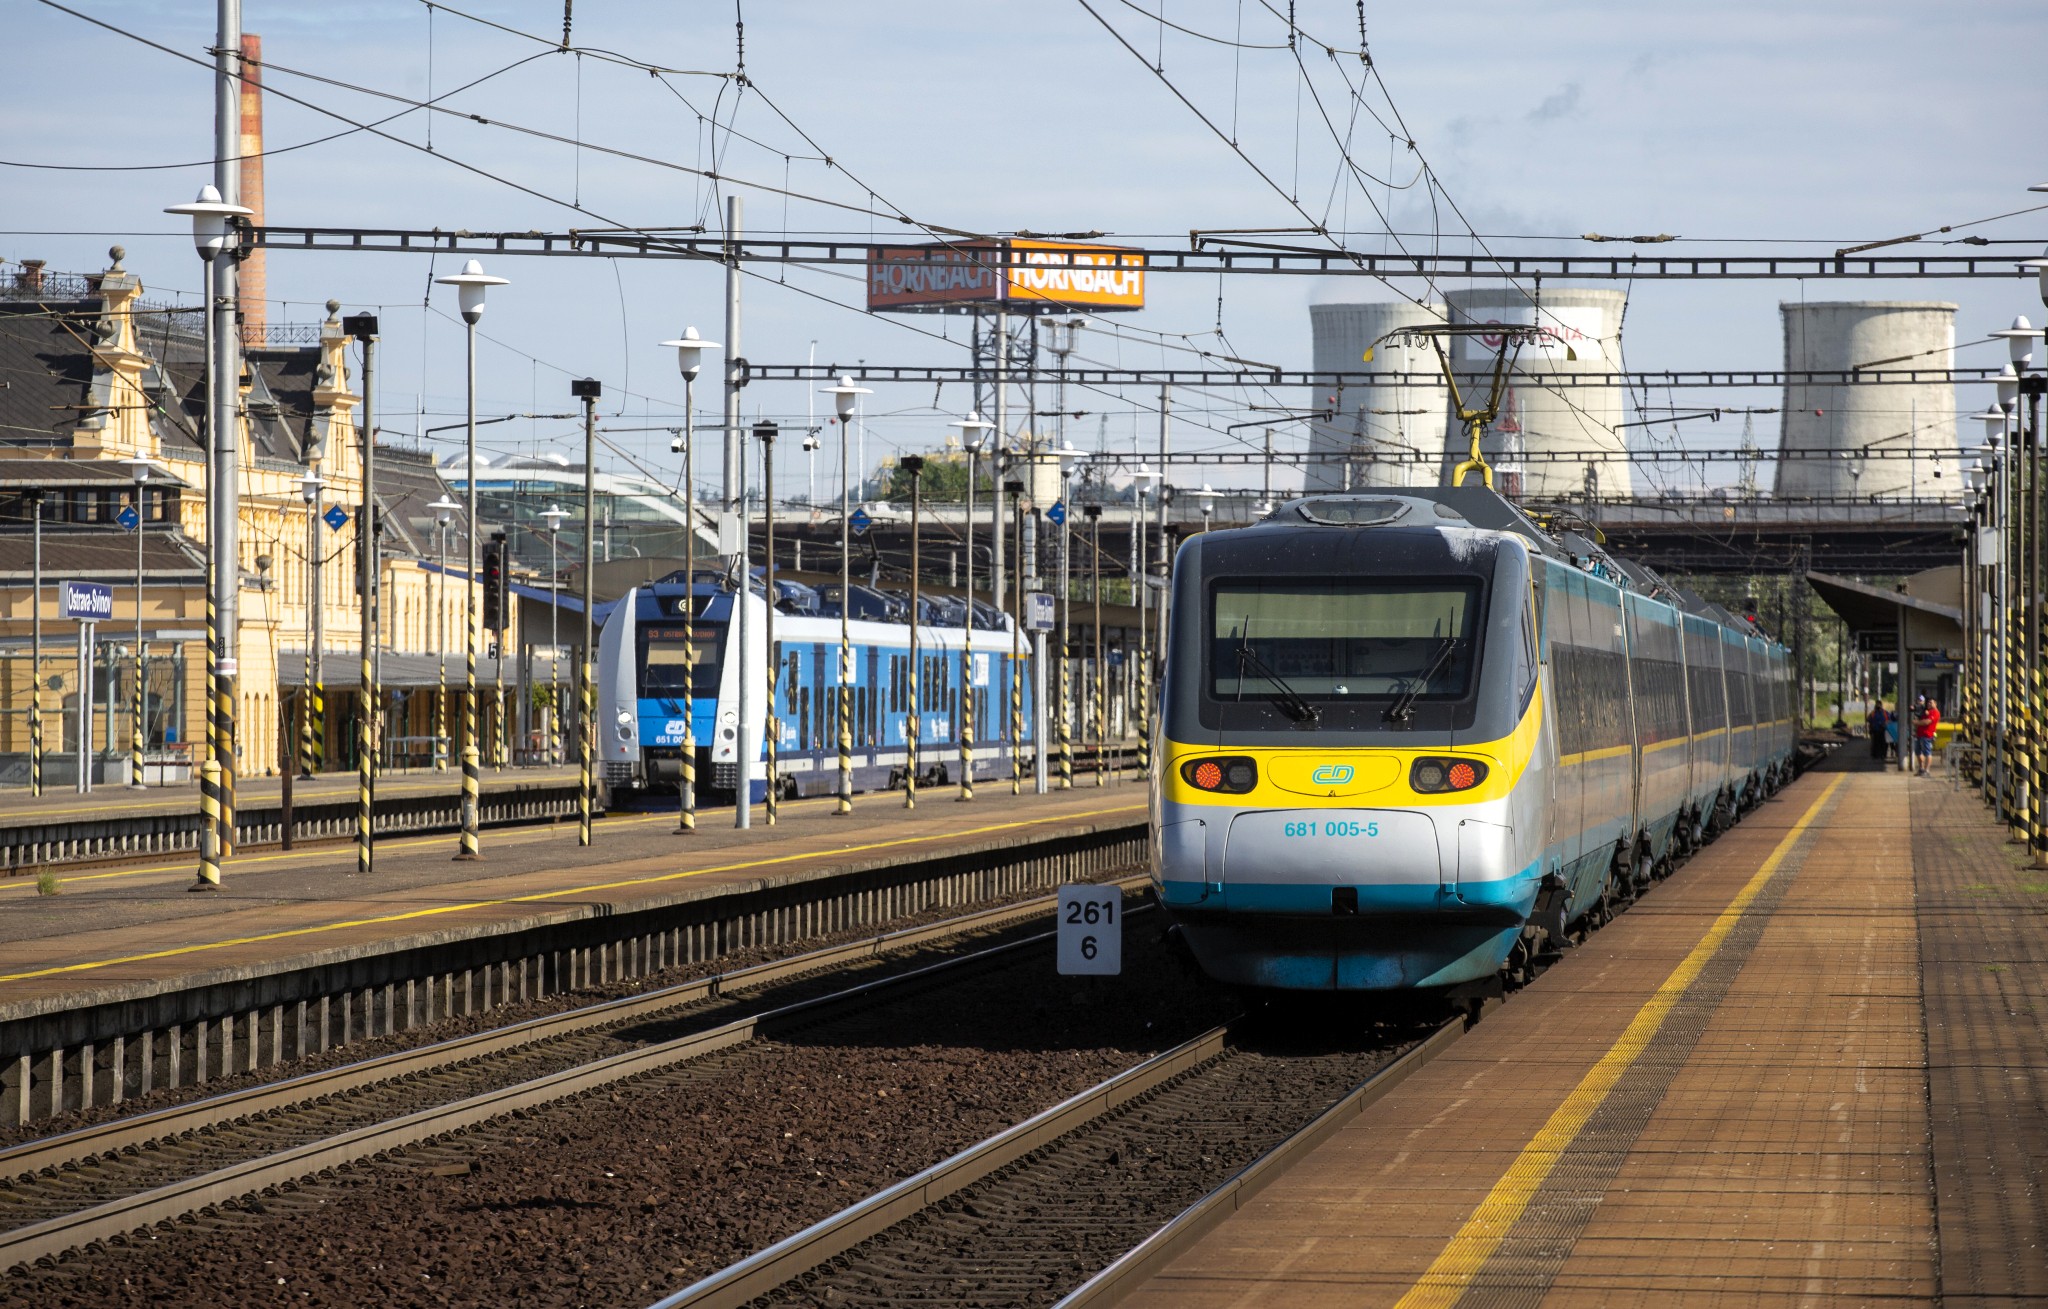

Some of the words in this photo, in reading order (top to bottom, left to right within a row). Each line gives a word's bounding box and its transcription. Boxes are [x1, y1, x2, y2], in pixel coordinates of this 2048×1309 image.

[871, 251, 993, 295] HORNBACH
[1011, 252, 1140, 295] HORNBACH
[68, 586, 111, 614] Ostrava-Svinov
[490, 643, 497, 659] 5
[1285, 822, 1317, 837] 681
[1325, 821, 1379, 837] 005-5
[1066, 901, 1113, 925] 261
[1081, 935, 1098, 960] 6
